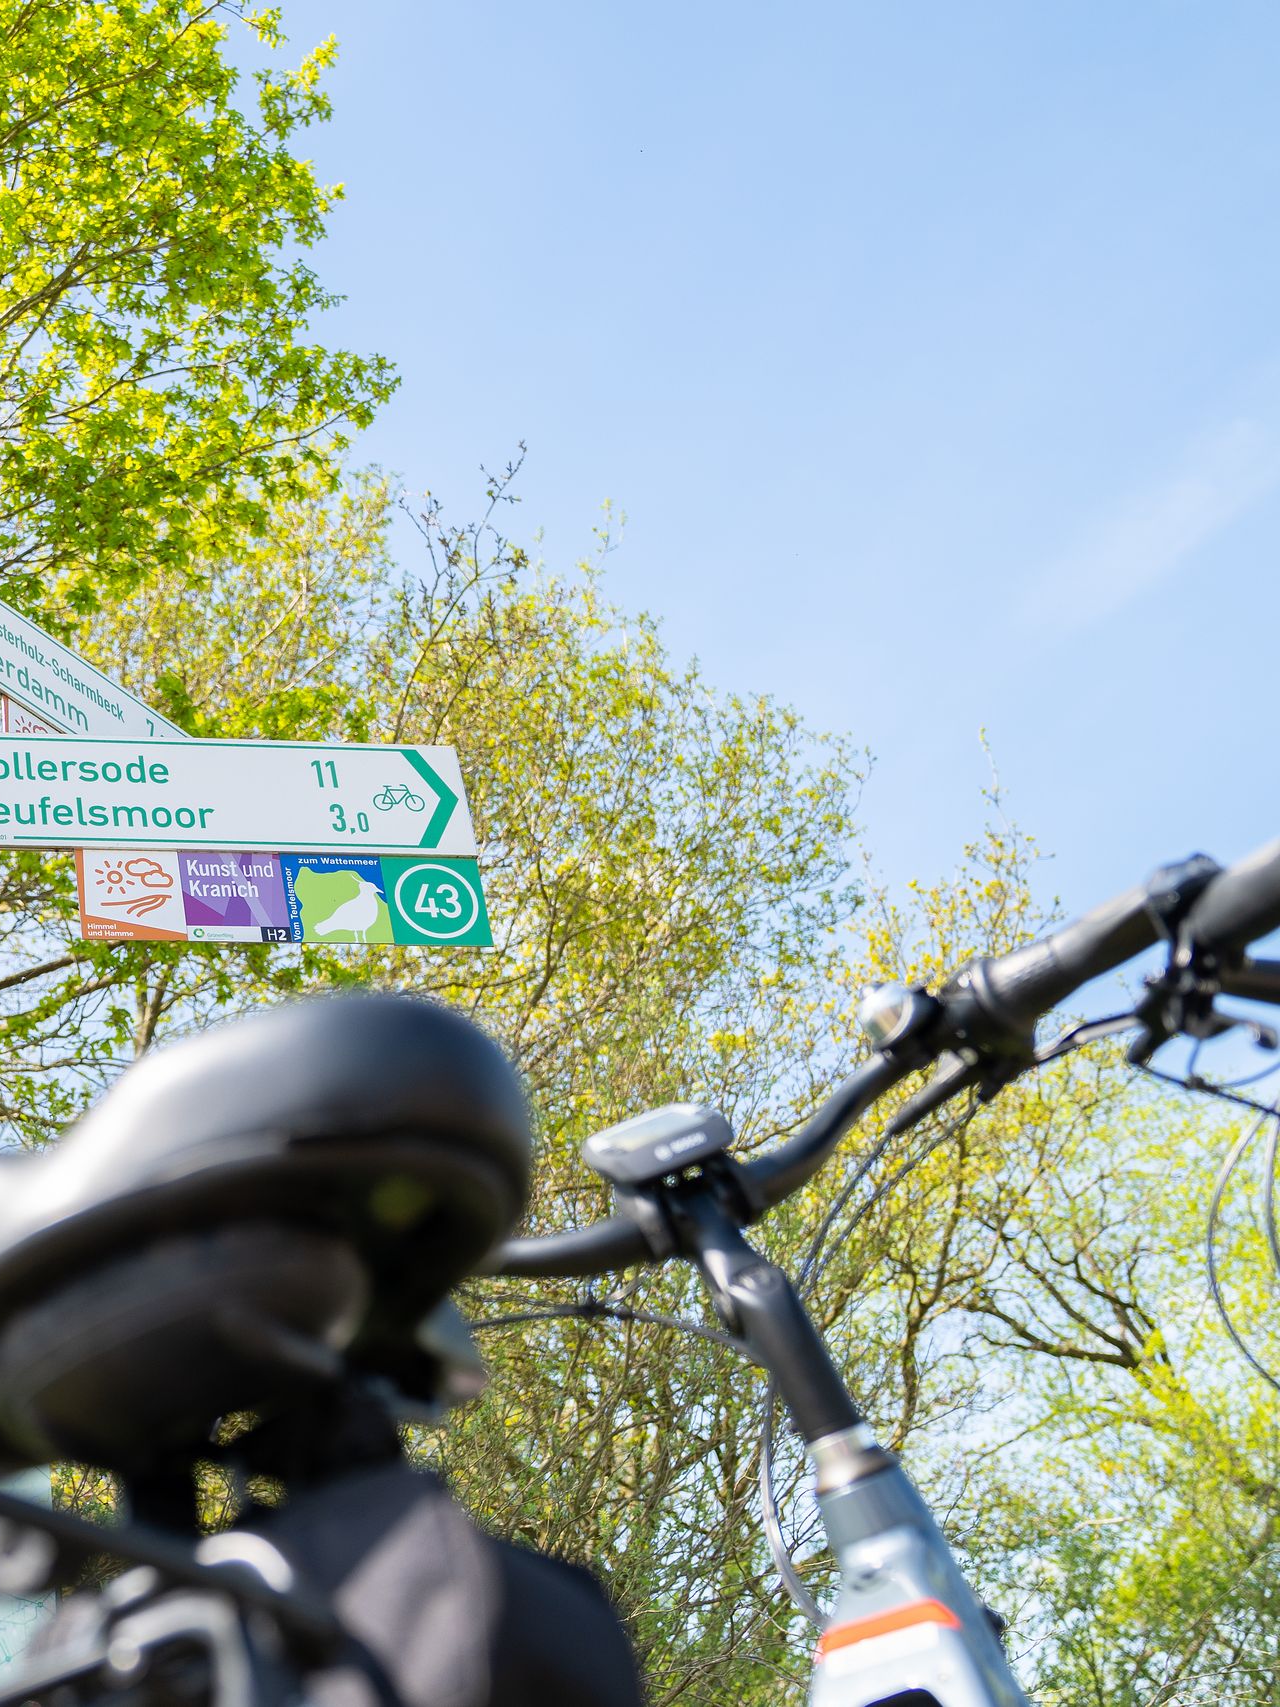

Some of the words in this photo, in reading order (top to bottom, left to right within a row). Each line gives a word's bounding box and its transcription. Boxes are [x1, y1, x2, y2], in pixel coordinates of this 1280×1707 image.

[310, 759, 339, 789] 11
[329, 803, 370, 835] 3,0
[186, 859, 238, 877] Kunst
[243, 861, 274, 878] und
[320, 857, 378, 867] Wattenmeer
[189, 880, 260, 898] Kranich
[285, 867, 299, 920] Teufelsmoor
[414, 883, 462, 919] 43
[267, 928, 287, 941] H2
[293, 921, 302, 941] Vom
